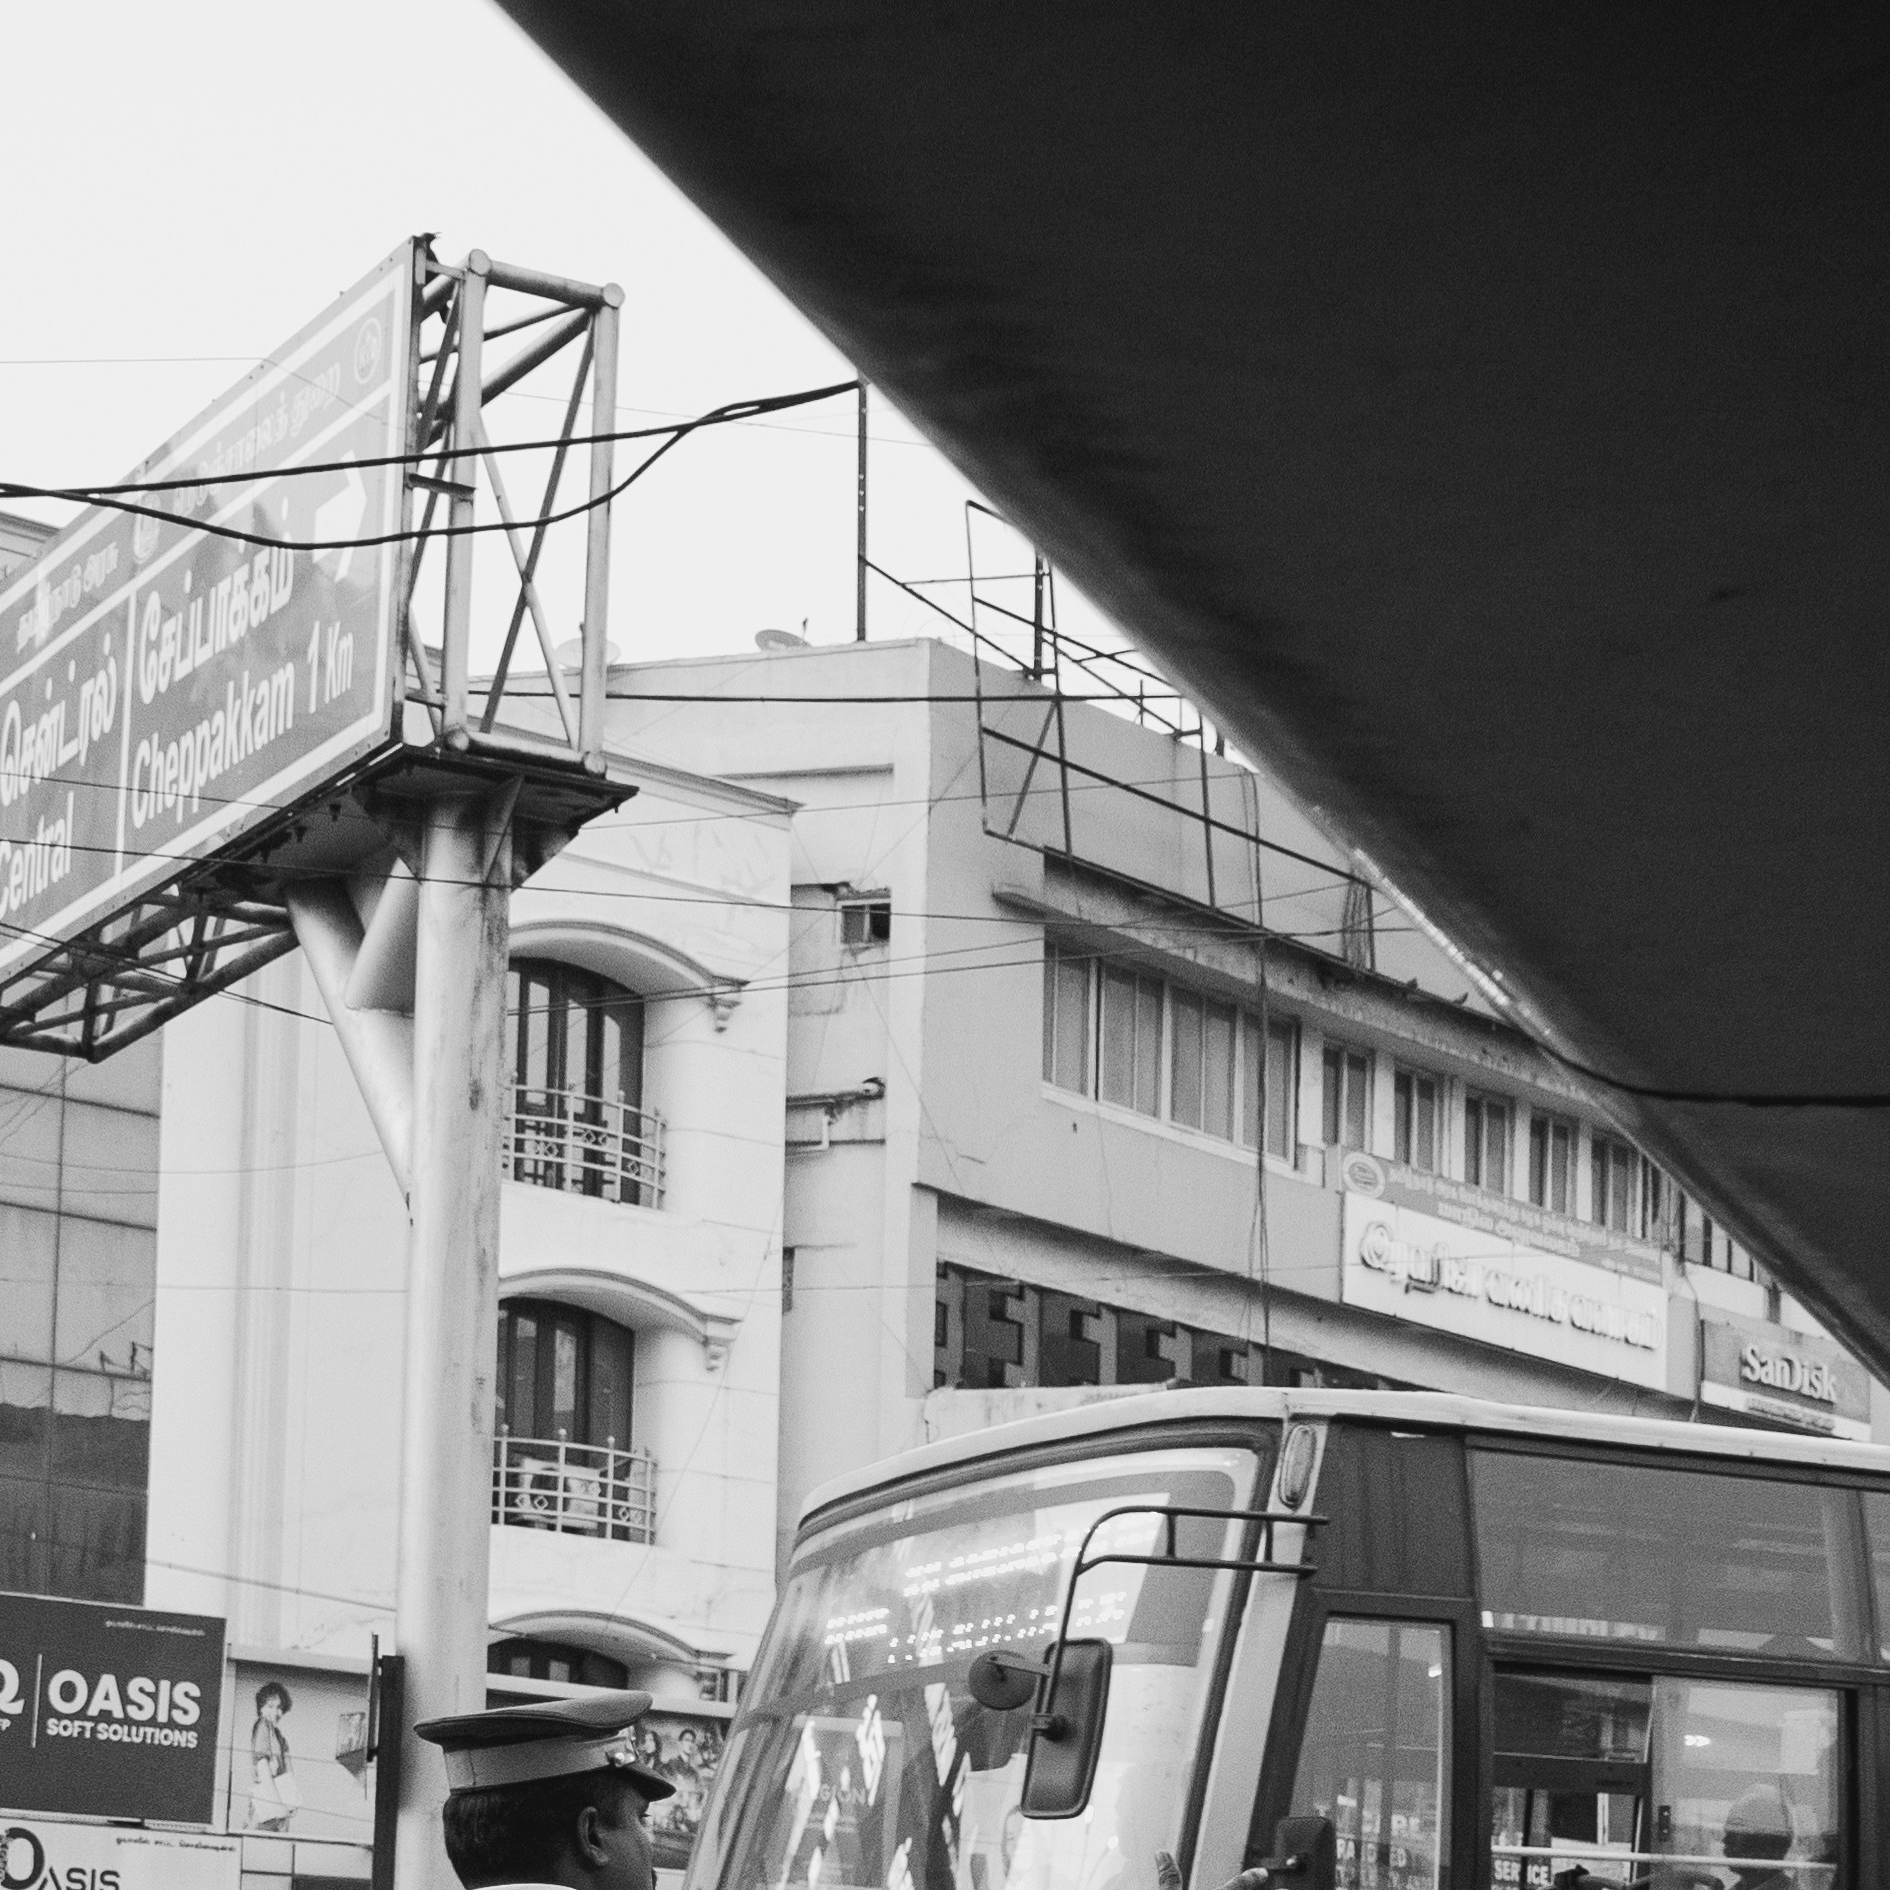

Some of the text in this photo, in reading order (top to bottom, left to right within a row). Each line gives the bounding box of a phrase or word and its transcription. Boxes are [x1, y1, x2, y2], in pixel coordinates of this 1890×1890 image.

[132, 620, 355, 829] Cheppakkam 1 Km
[1740, 1344, 1840, 1404] SanDisk
[47, 1668, 202, 1726] OASIS
[46, 1717, 199, 1750] SOFT SOLUTIONS
[1493, 1857, 1551, 1888] SERICE
